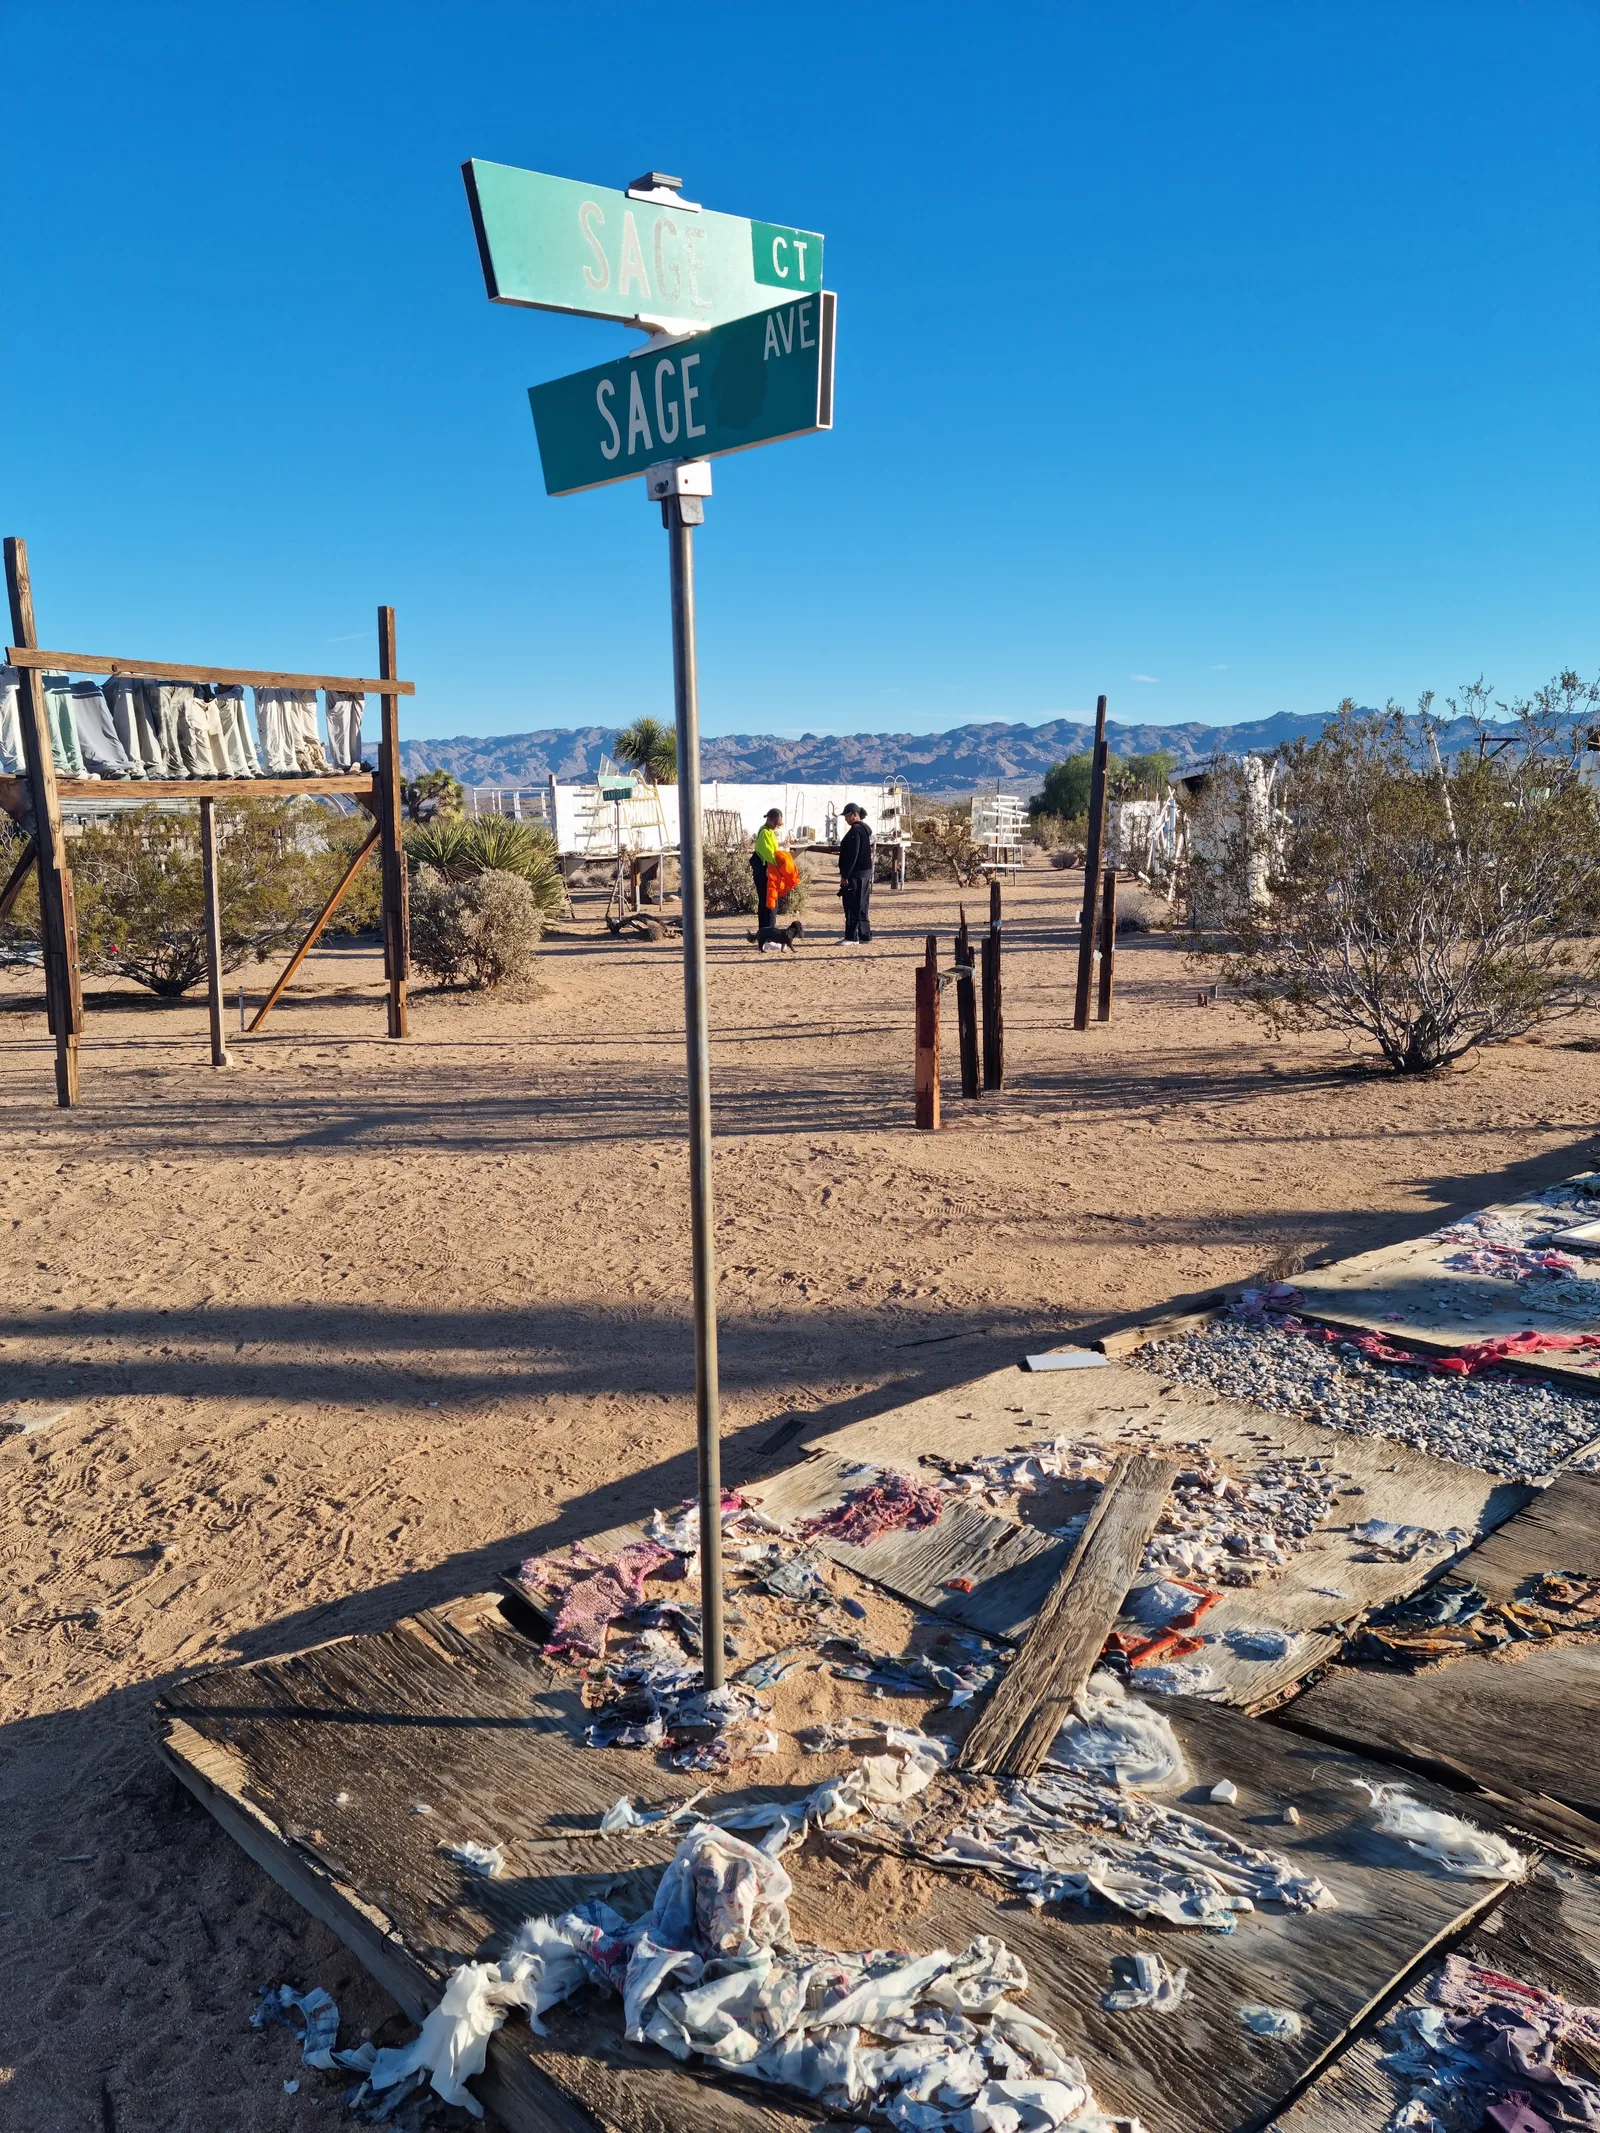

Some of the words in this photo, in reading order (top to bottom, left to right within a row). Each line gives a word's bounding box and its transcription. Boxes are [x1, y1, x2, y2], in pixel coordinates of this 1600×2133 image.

[580, 201, 711, 309] SAGE
[772, 236, 808, 282] CT
[596, 354, 706, 460] SAGE
[763, 301, 816, 361] AVE
